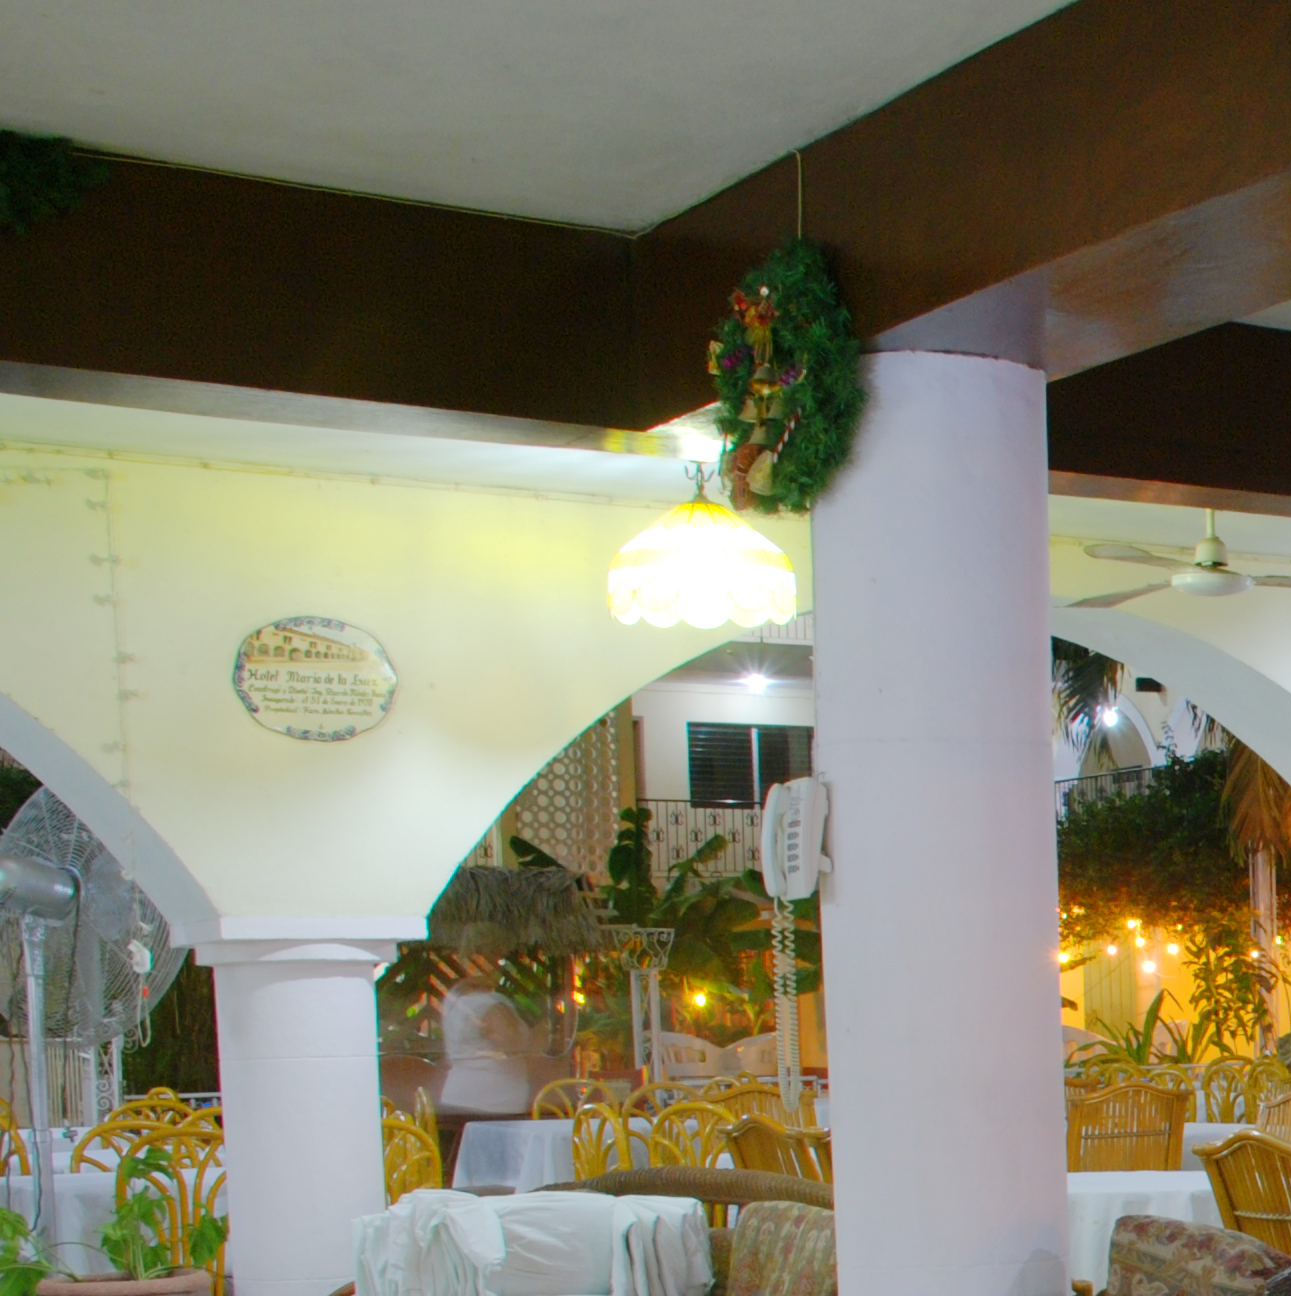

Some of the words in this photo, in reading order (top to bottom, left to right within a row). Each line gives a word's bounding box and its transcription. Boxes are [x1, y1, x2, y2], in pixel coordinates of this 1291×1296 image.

[247, 668, 278, 681] Hotel
[324, 672, 334, 684] de
[338, 673, 347, 685] la
[351, 673, 378, 686] Luz
